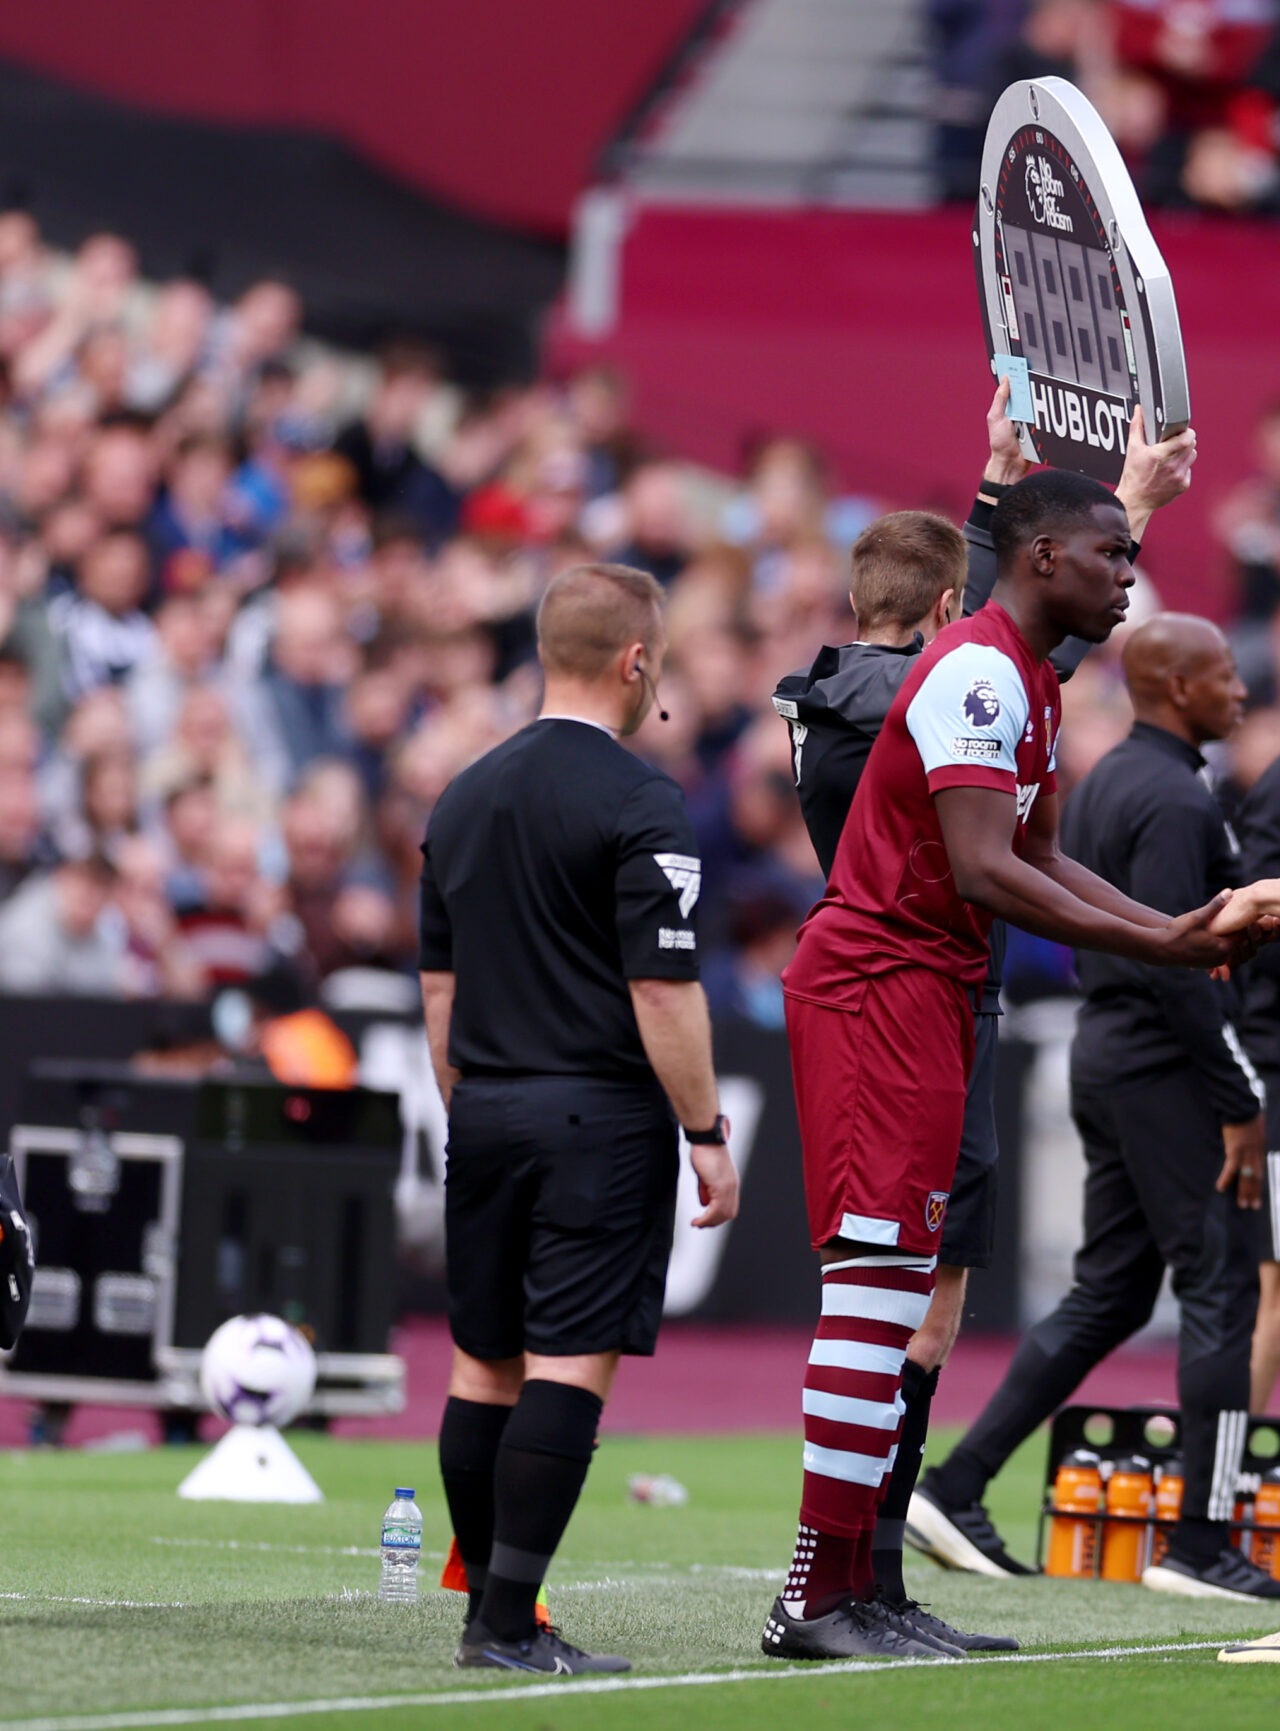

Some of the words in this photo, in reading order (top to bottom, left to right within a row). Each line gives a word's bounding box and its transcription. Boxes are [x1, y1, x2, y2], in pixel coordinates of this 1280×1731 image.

[1038, 155, 1052, 178] No
[1030, 381, 1126, 455] HUBLOT
[953, 738, 968, 749] No
[968, 740, 998, 750] room
